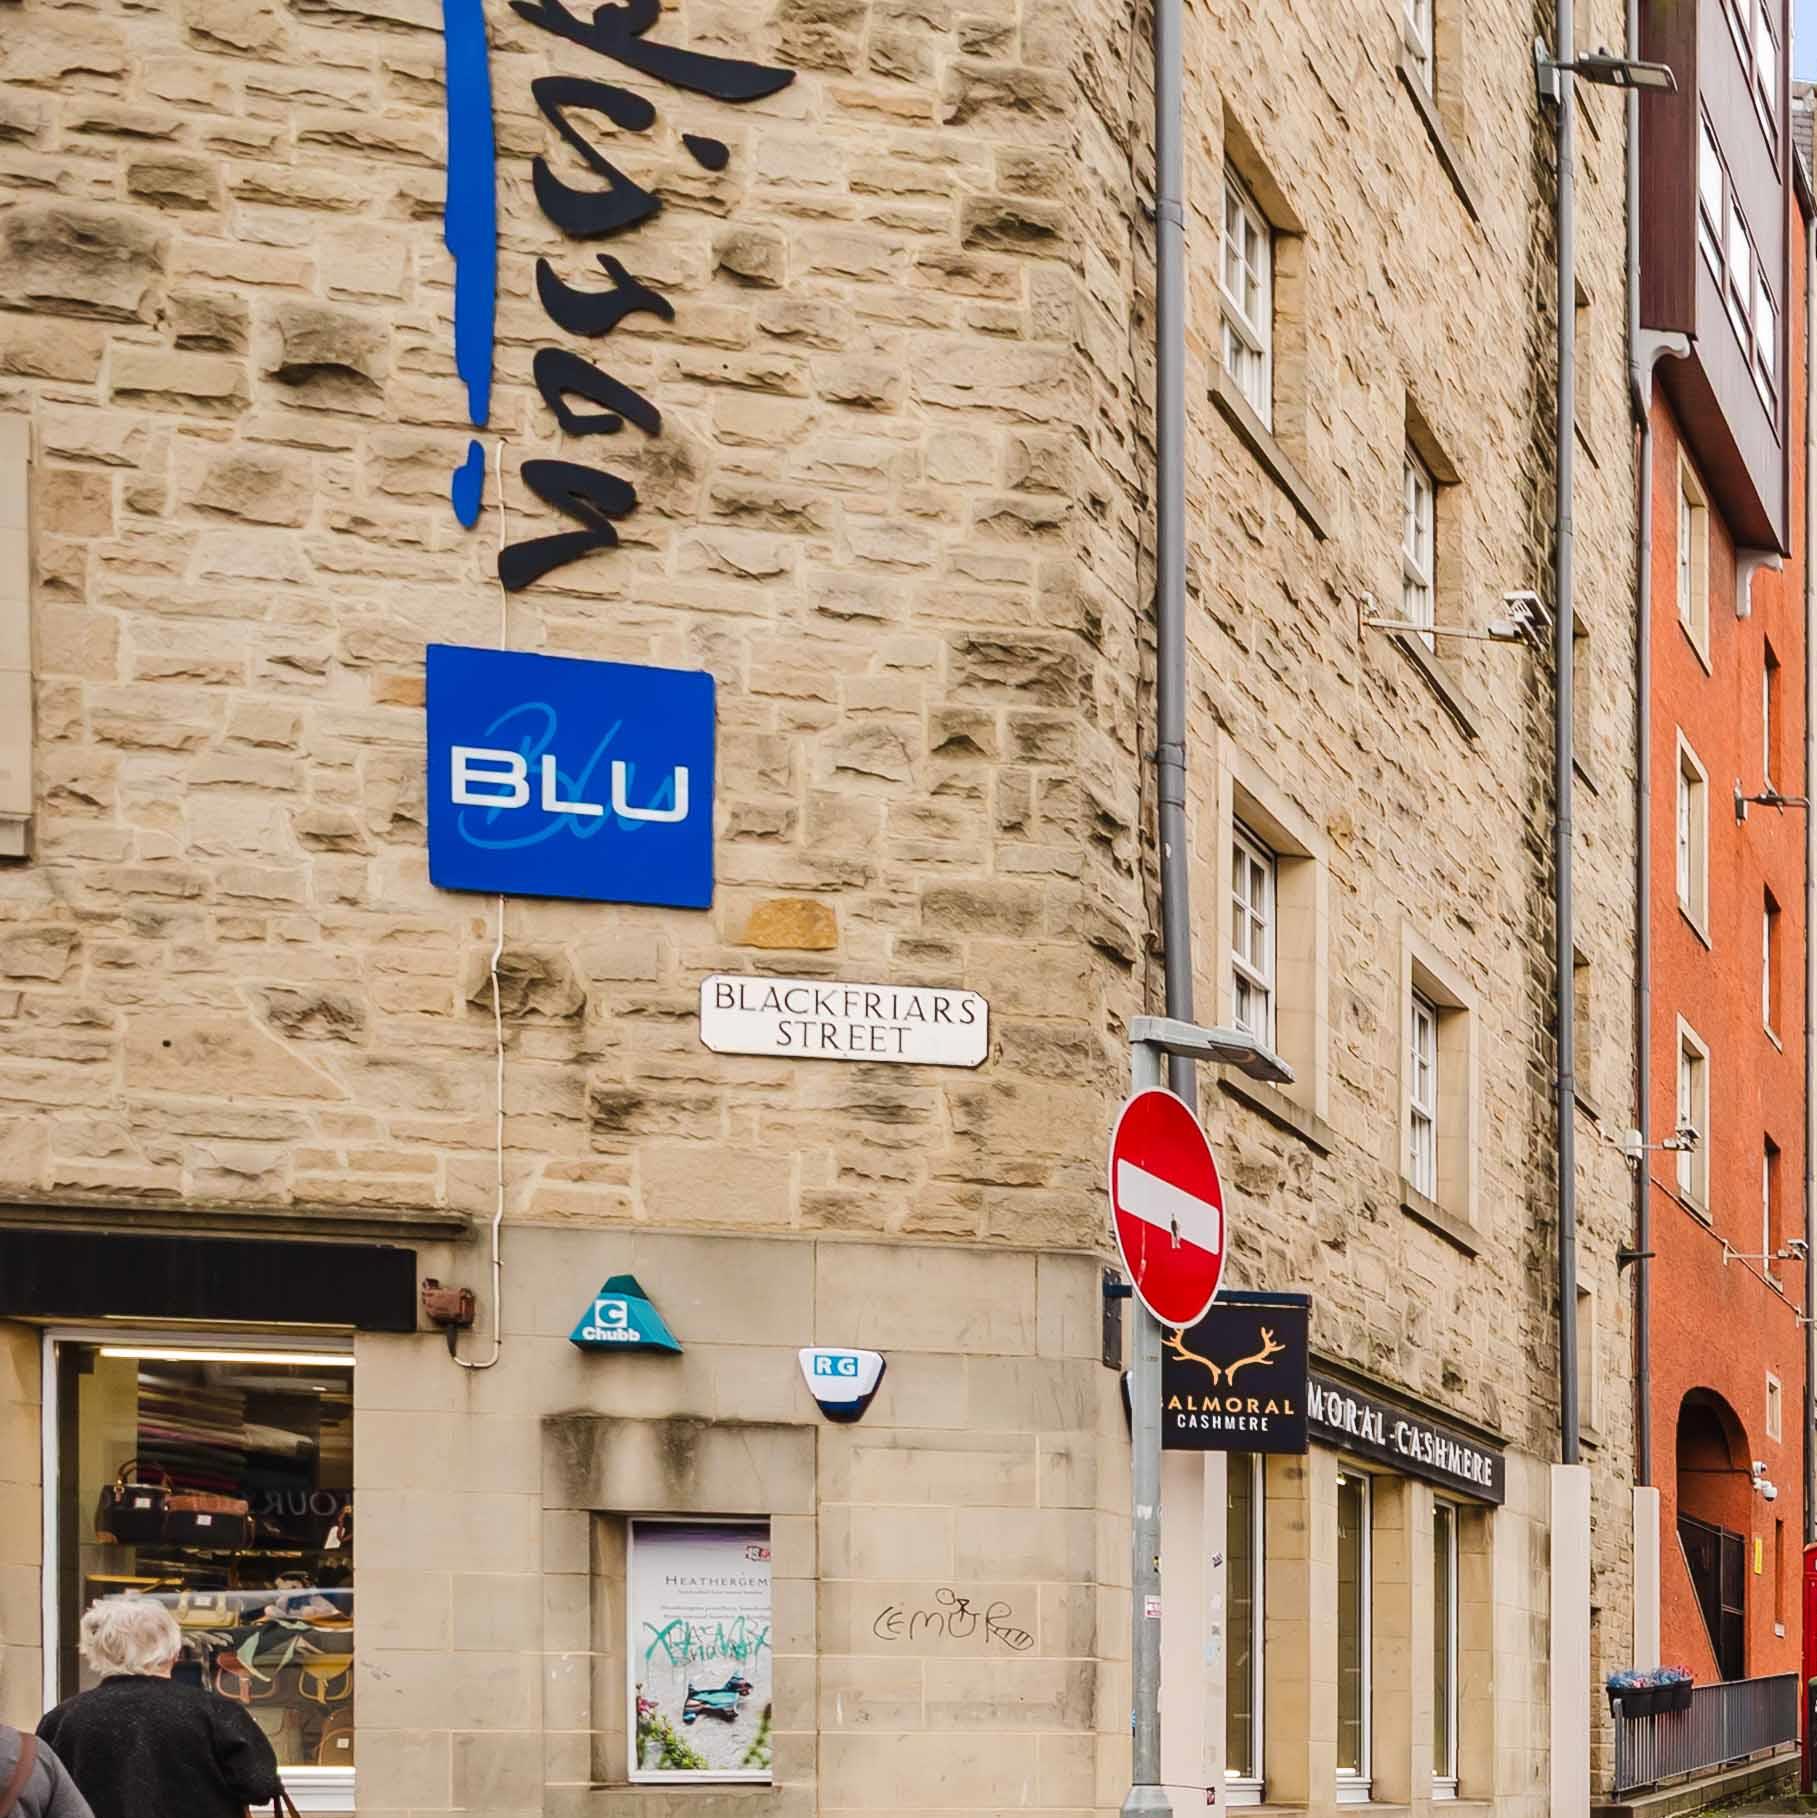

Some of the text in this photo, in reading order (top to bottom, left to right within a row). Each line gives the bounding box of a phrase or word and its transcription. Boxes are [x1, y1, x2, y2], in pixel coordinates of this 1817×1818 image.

[450, 746, 690, 823] BLU
[714, 982, 976, 1026] BLACKFRIARS
[776, 1020, 912, 1054] STREET
[582, 1326, 641, 1342] Chubb
[1161, 1394, 1296, 1416] ALMORAL
[1176, 1414, 1270, 1432] CASHMERE
[1307, 1379, 1494, 1487] MORAL CASHMERE
